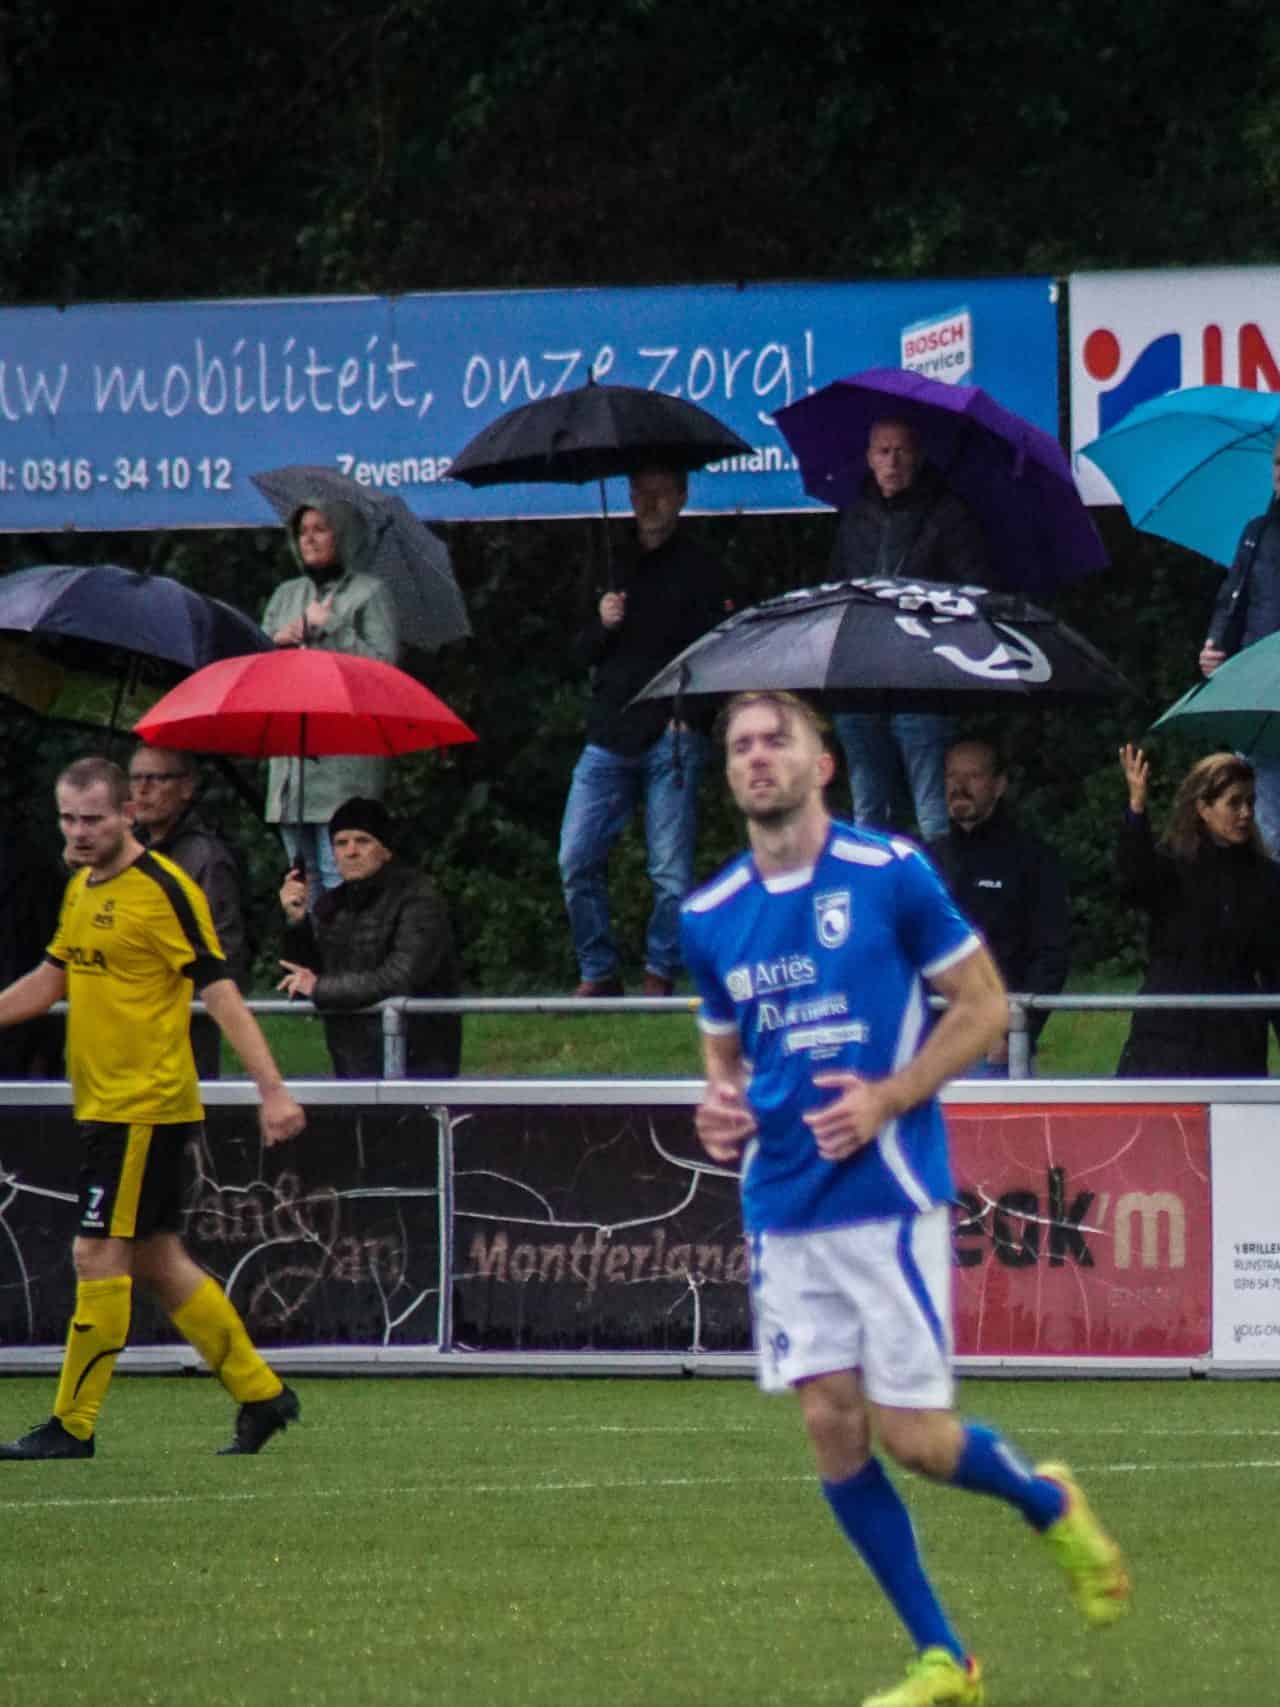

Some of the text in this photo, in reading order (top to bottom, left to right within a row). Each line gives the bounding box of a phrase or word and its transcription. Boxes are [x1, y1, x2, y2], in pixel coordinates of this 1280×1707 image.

[905, 323, 964, 360] BOSCH
[94, 335, 434, 417] mobiliteit,
[22, 458, 92, 491] 0316
[113, 458, 149, 491] 34
[157, 457, 190, 489] 10
[199, 457, 233, 489] 12
[336, 453, 455, 487] Zevenaa
[957, 1167, 1185, 1268] eak'm
